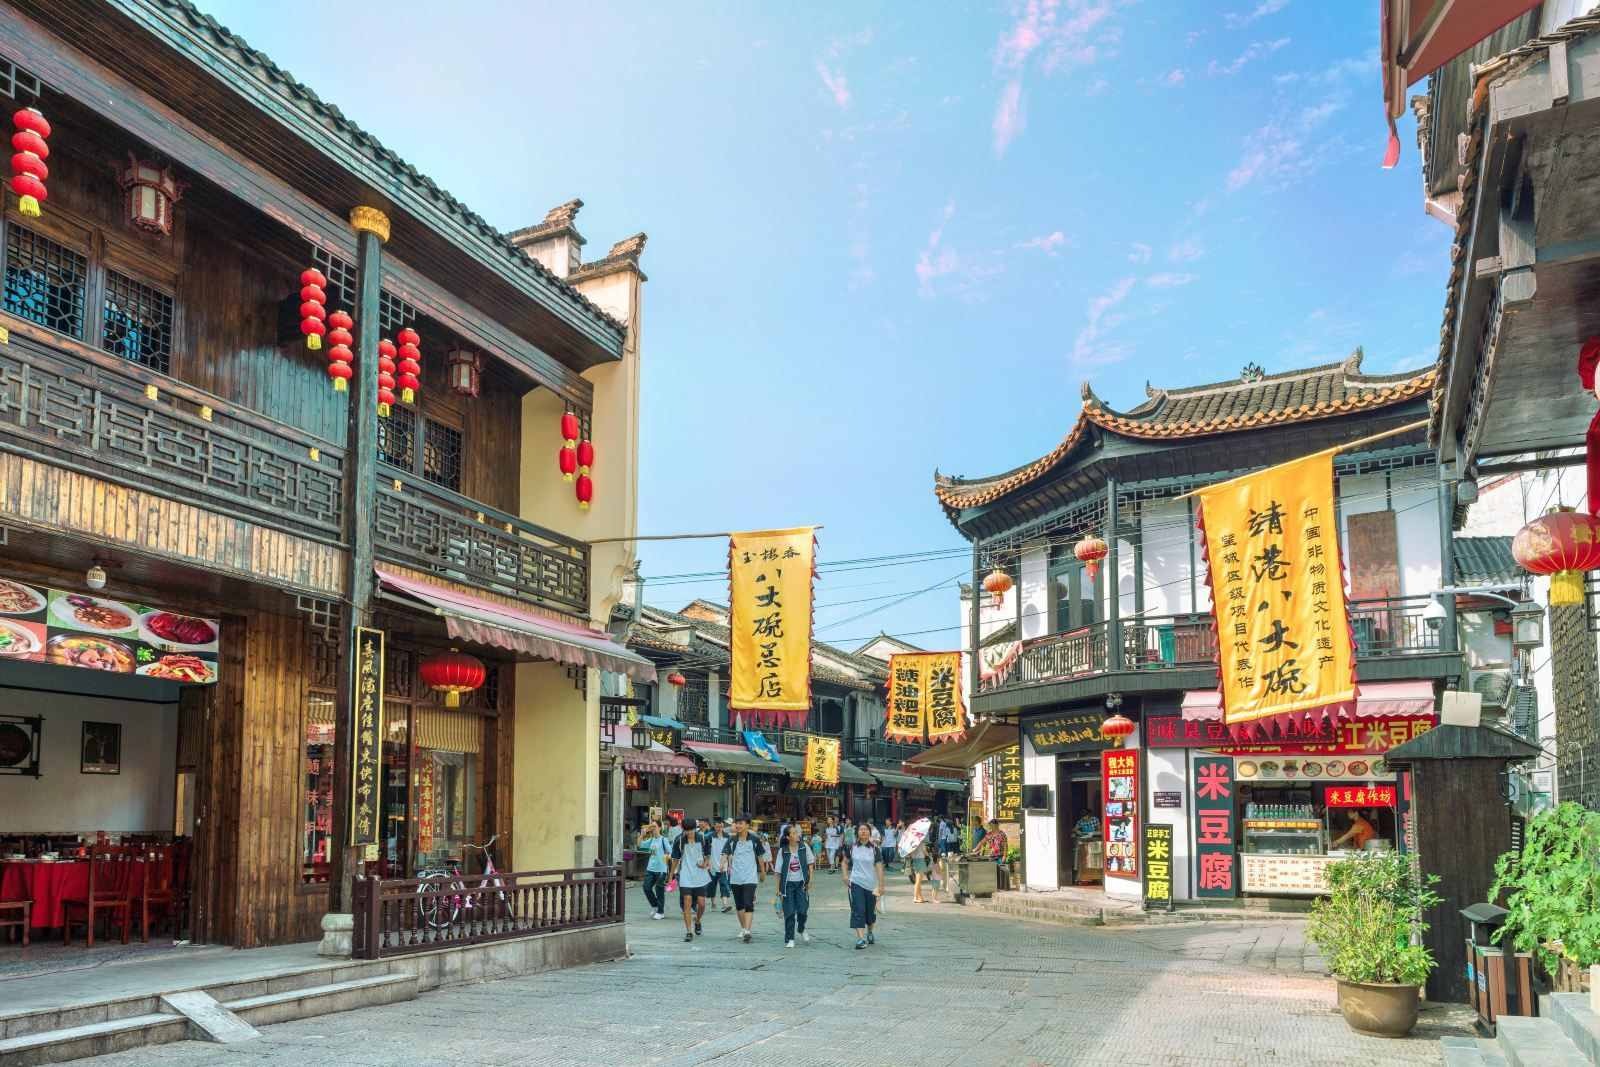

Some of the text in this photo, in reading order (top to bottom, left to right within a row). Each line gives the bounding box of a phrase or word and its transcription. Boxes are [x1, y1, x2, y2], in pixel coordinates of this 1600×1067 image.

[1221, 533, 1255, 689] 望城区级项目代表作
[1247, 500, 1308, 698] 靖港八大碗
[931, 665, 957, 729] 米豆腐
[1196, 762, 1233, 891] 米豆腐
[1329, 789, 1393, 806] 米豆腐作坊
[1146, 840, 1170, 900] 米豆腐
